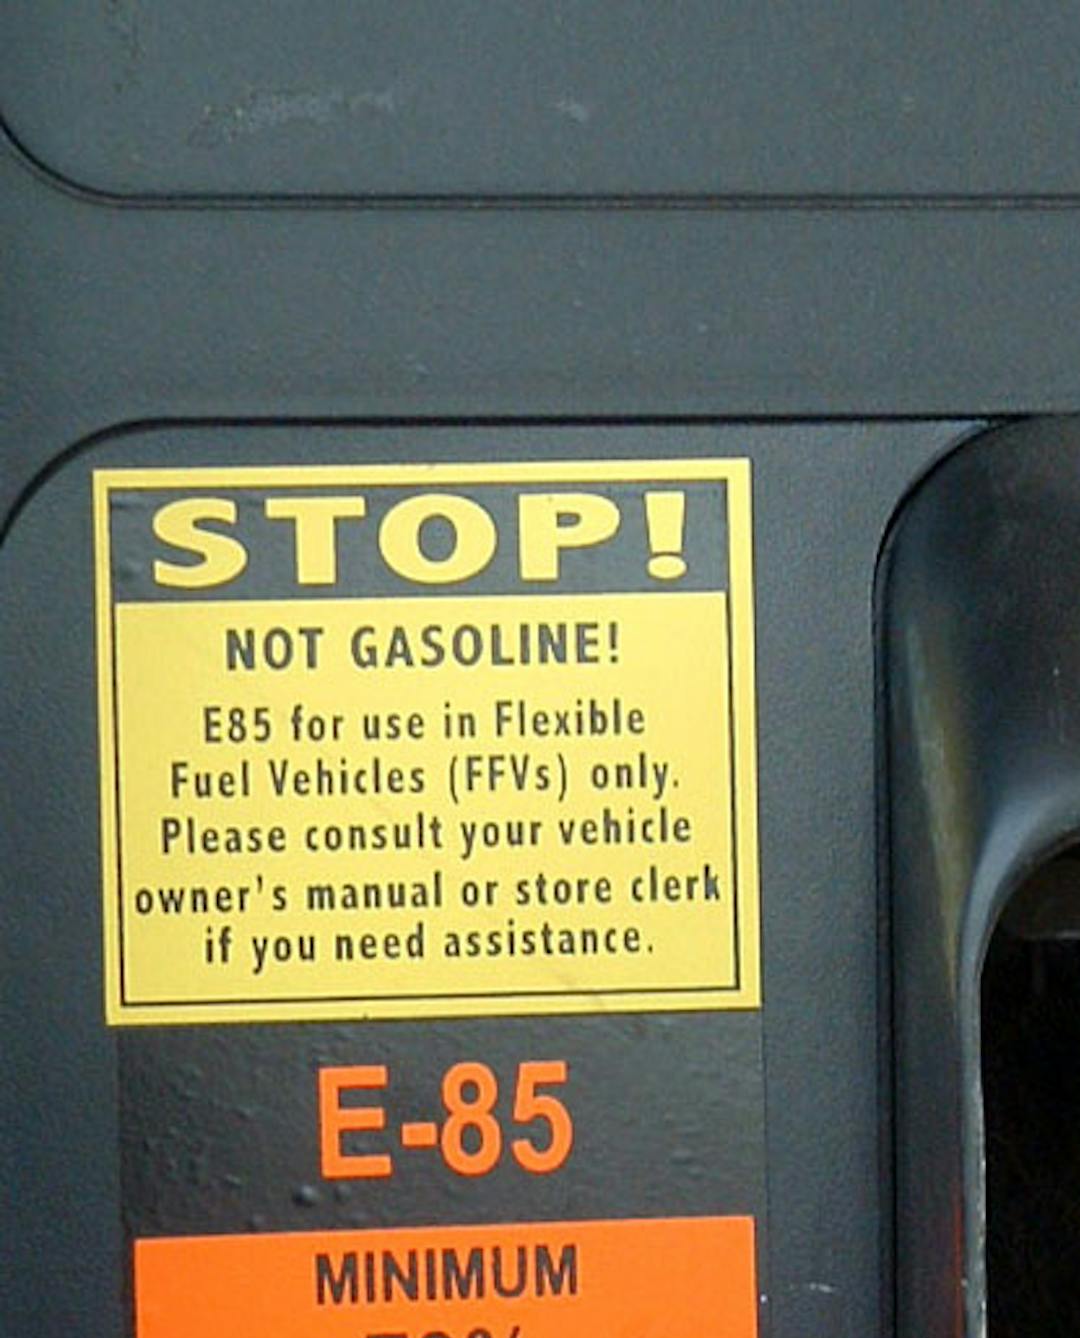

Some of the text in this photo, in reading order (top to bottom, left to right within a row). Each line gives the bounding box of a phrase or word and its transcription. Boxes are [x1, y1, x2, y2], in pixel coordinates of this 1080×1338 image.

[152, 490, 687, 588] STOP!
[226, 622, 618, 671] NOT GASOLINE!
[204, 699, 645, 743] E85 for use in Flexible
[171, 752, 680, 804] Fuel Vehicles (FFVs) only.
[161, 807, 691, 860] Please consult your vehicle
[135, 863, 720, 915] owner's manual or store clerk
[205, 921, 654, 975] if you need assistance.
[318, 1060, 574, 1180] E-85
[315, 1245, 578, 1304] MINIMUM
